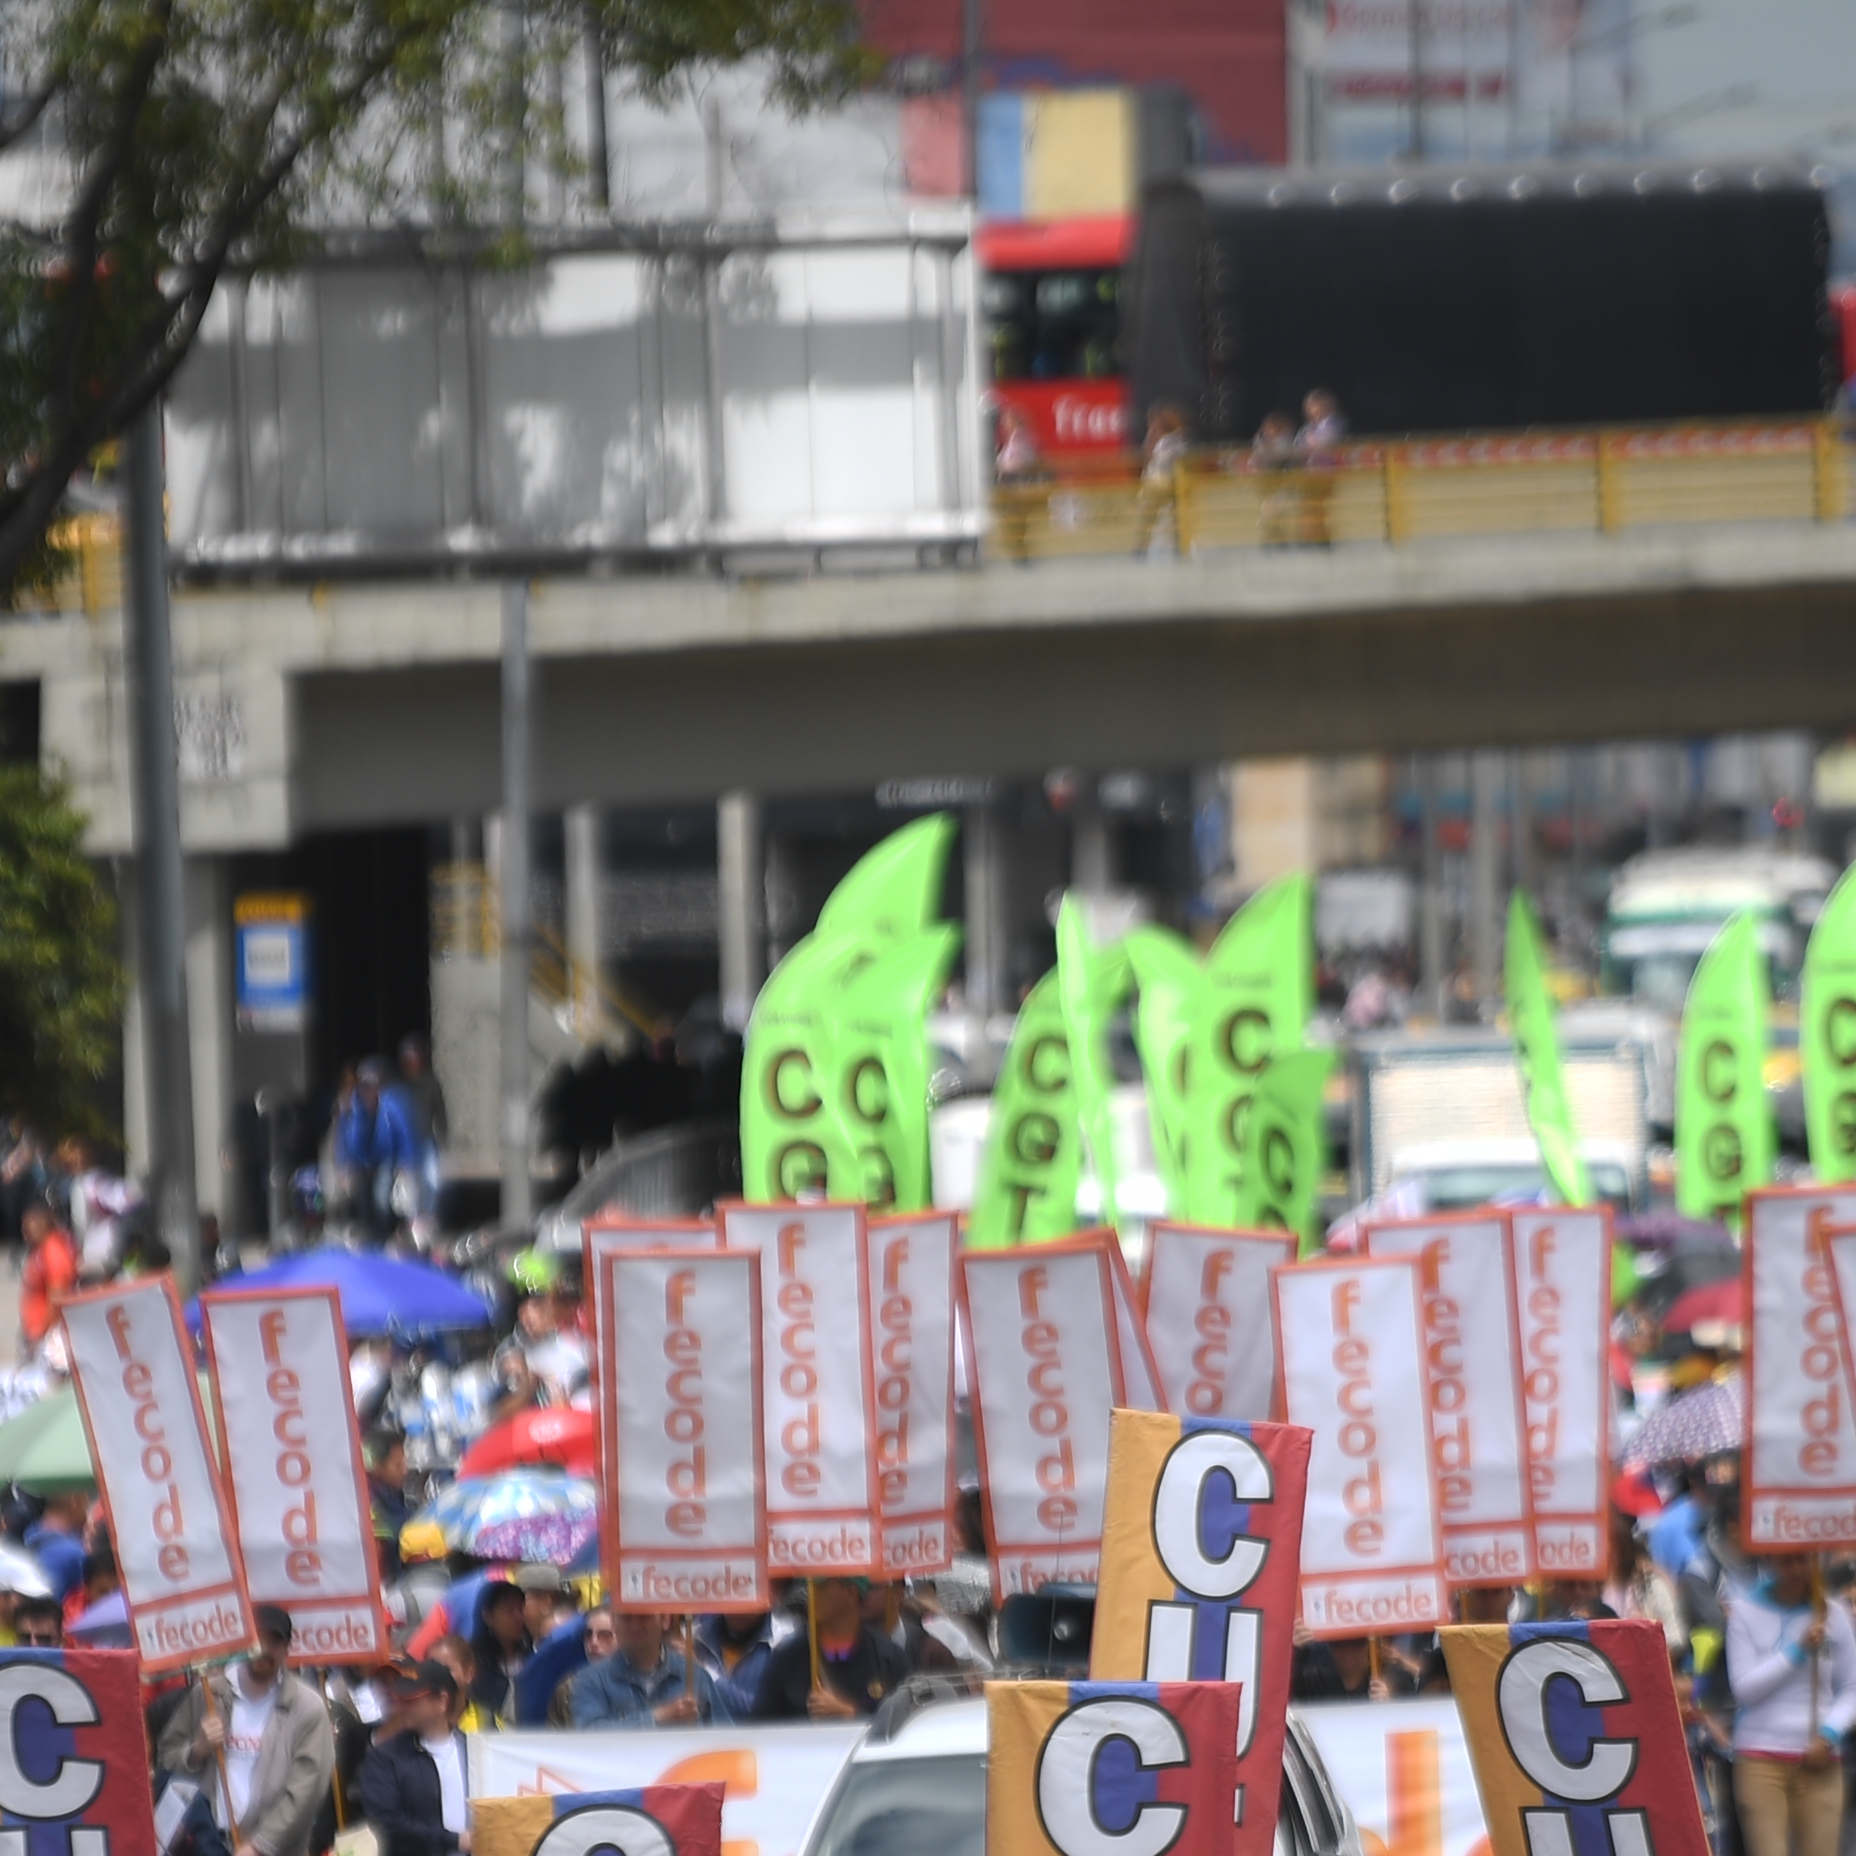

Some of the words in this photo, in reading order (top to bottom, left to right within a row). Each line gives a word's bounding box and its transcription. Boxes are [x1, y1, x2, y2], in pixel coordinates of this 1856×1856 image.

[664, 1270, 707, 1538] fecode
[777, 1221, 821, 1499] fecode
[1017, 1264, 1078, 1533] fecode
[1184, 1248, 1233, 1416] feco
[105, 1303, 191, 1584] fecode
[257, 1306, 322, 1586] fecode
[1329, 1277, 1384, 1557] fecode
[154, 1602, 240, 1655] fecode
[643, 1563, 750, 1599] fecode
[881, 1529, 939, 1568] code
[1324, 1583, 1432, 1621] fecode
[1445, 1543, 1519, 1577] code
[289, 1615, 369, 1654] ecode
